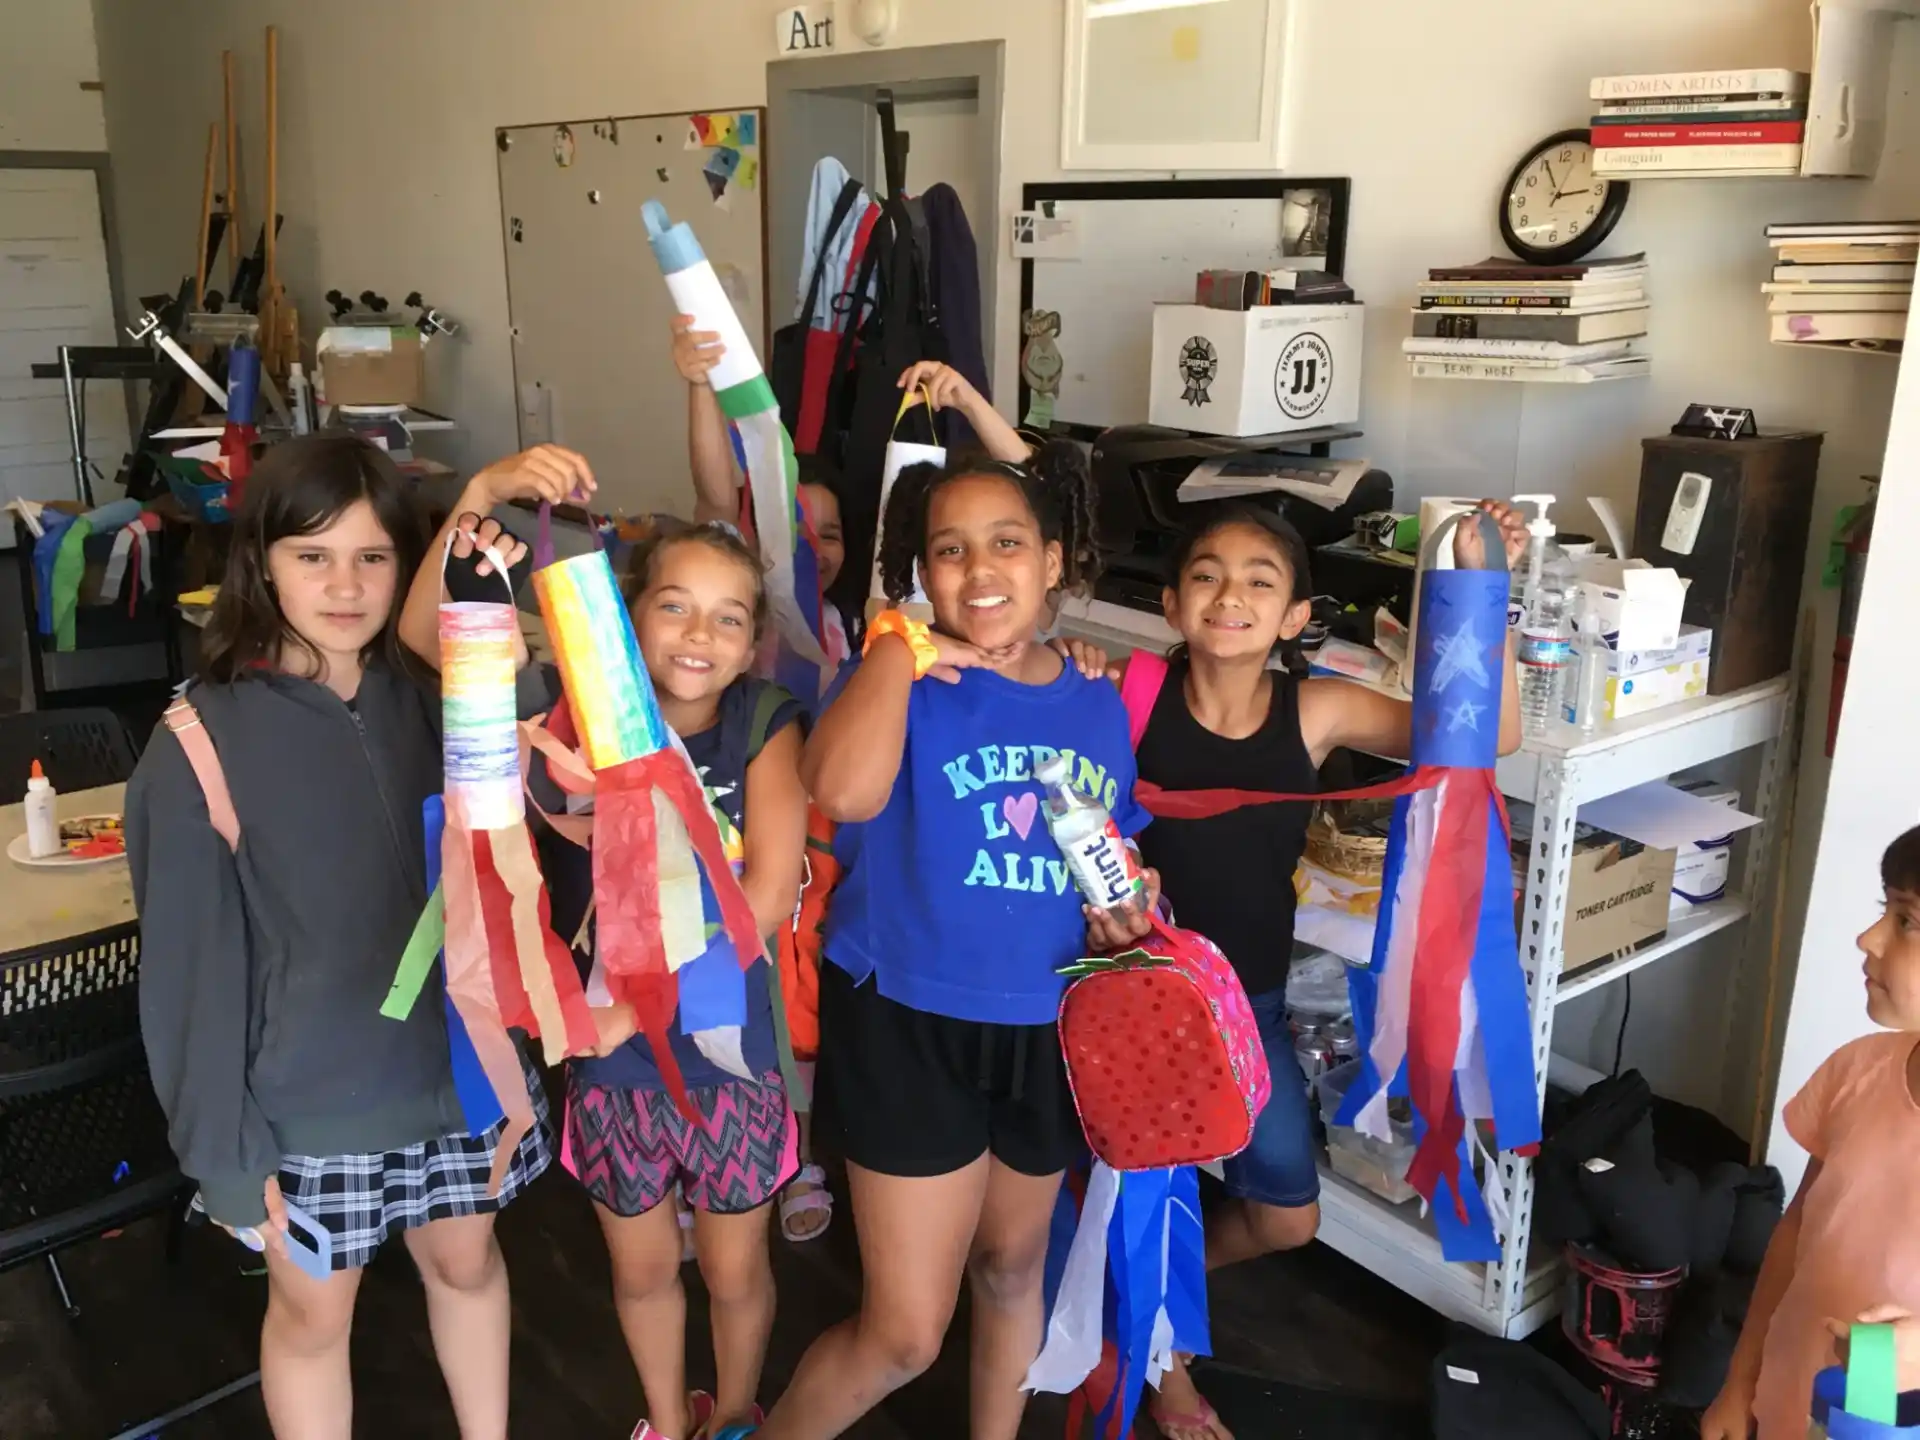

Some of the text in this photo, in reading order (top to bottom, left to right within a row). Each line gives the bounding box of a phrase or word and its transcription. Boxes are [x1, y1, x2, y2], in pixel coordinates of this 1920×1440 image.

[786, 10, 833, 51] Art
[1612, 77, 1742, 94] WOMEN ARTISTS
[1558, 150, 1572, 163] 12
[1580, 152, 1586, 164] 1
[1525, 176, 1538, 188] 10
[1594, 184, 1604, 197] 3
[1516, 196, 1526, 208] 9
[1585, 205, 1595, 215] 4
[1519, 215, 1529, 227] 8
[1568, 221, 1579, 234] 5
[1548, 231, 1558, 243] 6
[1281, 340, 1305, 372] JIMMY
[1186, 359, 1210, 368] SUPER
[1444, 362, 1515, 377] READ MORE
[1290, 358, 1317, 395] JJ
[963, 848, 1085, 896] ALIV
[1083, 835, 1131, 903] hint
[1576, 880, 1656, 922] TONER CARTRIDGE
